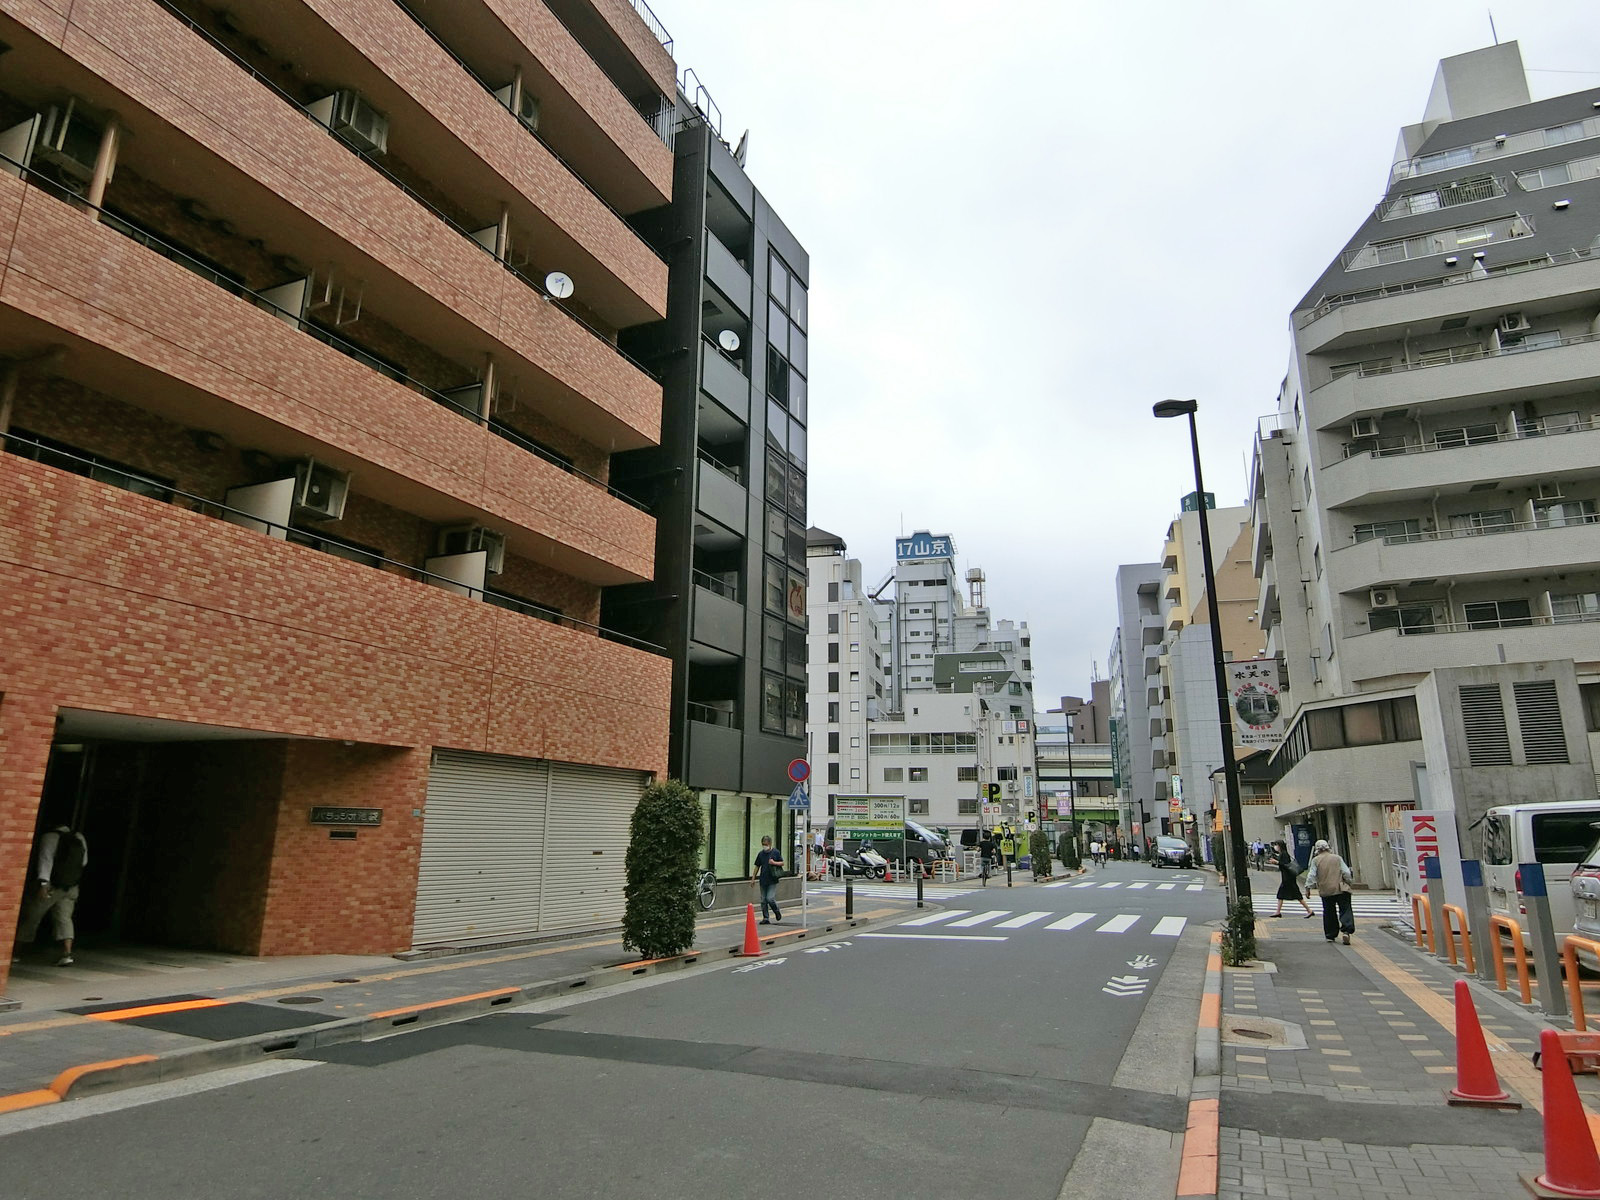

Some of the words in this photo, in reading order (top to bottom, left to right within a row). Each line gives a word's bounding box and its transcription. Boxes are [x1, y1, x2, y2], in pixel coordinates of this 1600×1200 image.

[897, 539, 947, 556] 17山京
[1234, 669, 1271, 680] 水天宮
[988, 783, 1001, 803] P
[983, 806, 1000, 814] 出口
[1028, 811, 1036, 823] P
[1411, 815, 1441, 894] KIR
